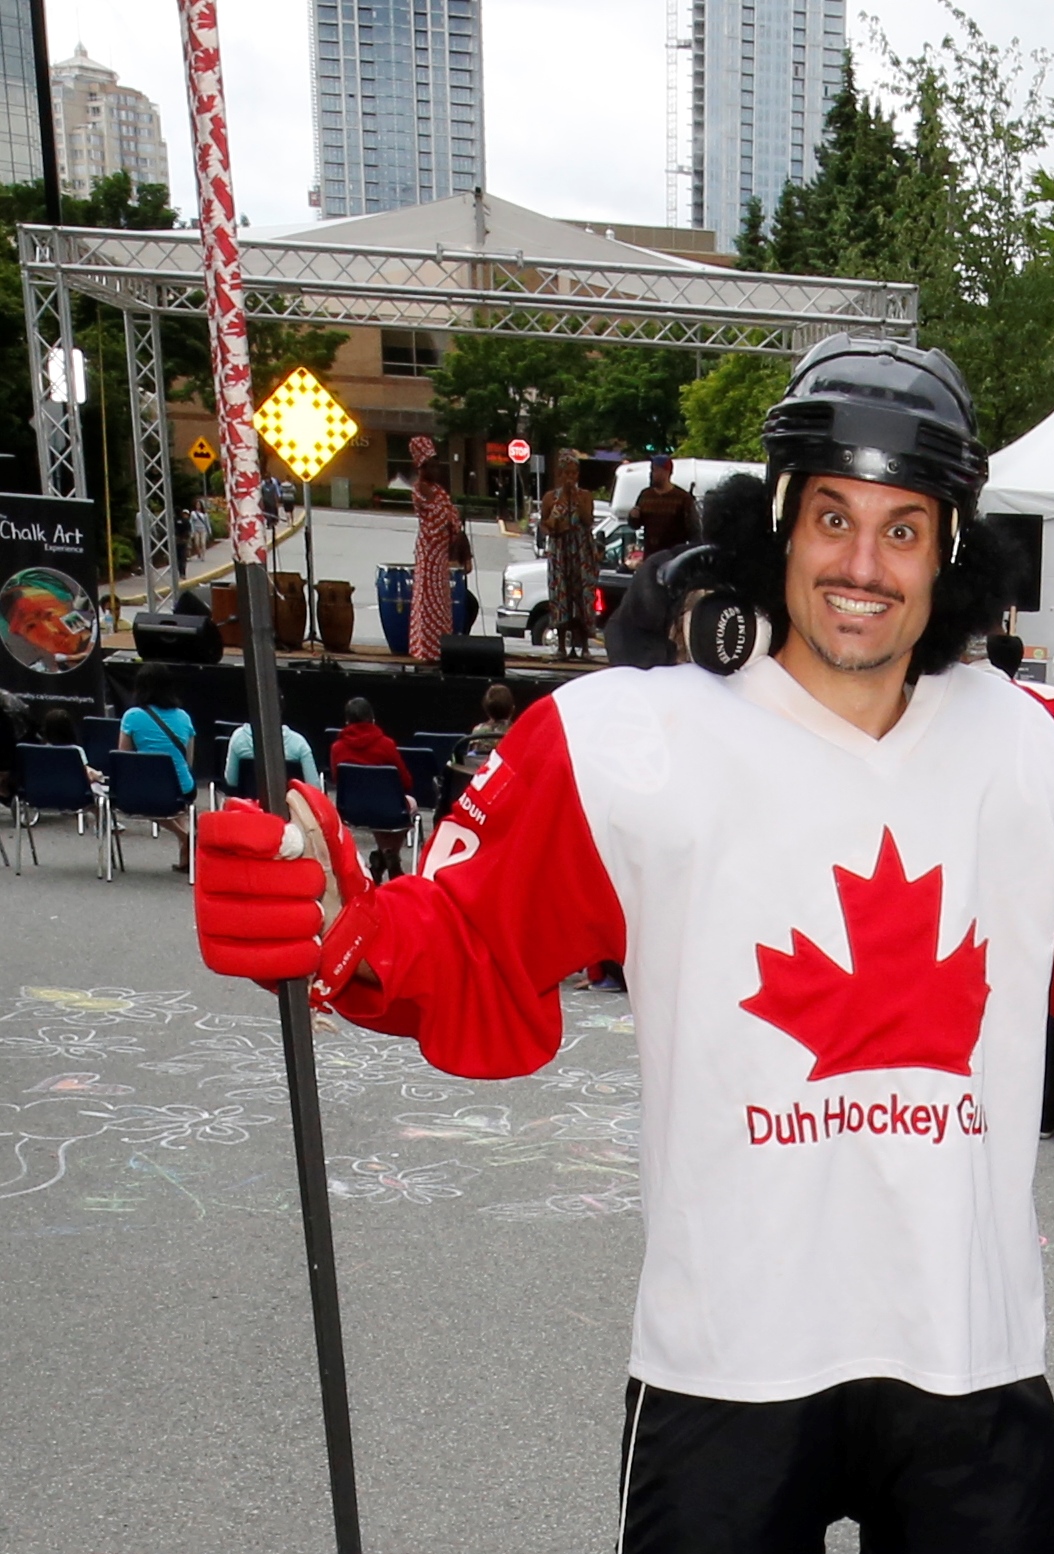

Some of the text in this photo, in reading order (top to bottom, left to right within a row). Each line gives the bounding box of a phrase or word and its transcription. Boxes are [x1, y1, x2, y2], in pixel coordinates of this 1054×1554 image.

[510, 447, 529, 458] STOP
[0, 520, 84, 544] Chalk Art
[44, 544, 84, 553] Experience
[458, 792, 487, 826] ADUH
[746, 1102, 818, 1145] Duh
[823, 1093, 950, 1145] Hockey
